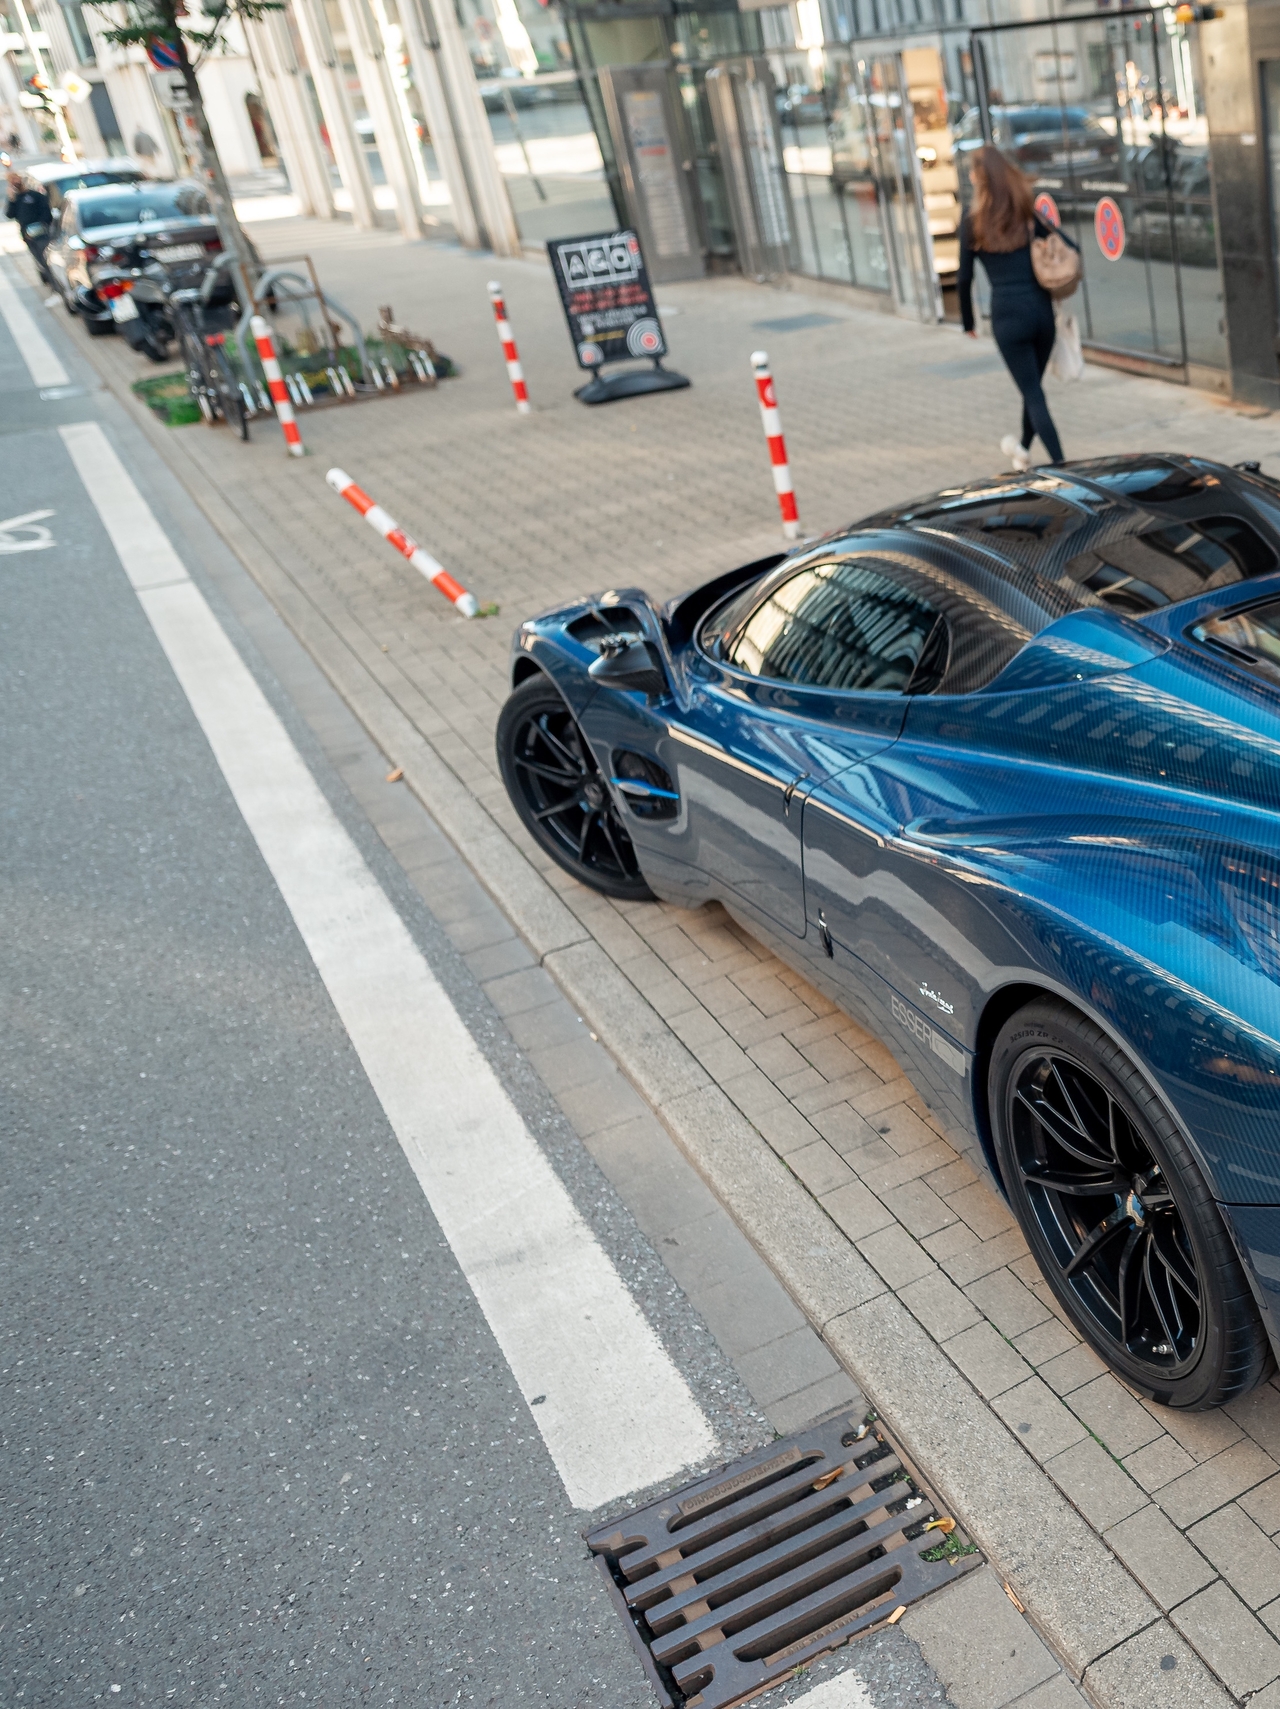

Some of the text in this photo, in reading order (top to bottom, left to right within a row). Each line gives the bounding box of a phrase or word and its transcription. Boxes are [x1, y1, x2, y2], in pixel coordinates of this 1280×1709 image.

[891, 995, 932, 1049] ESSER
[1010, 1029, 1035, 1043] 325/30
[1037, 1030, 1049, 1038] ZR
